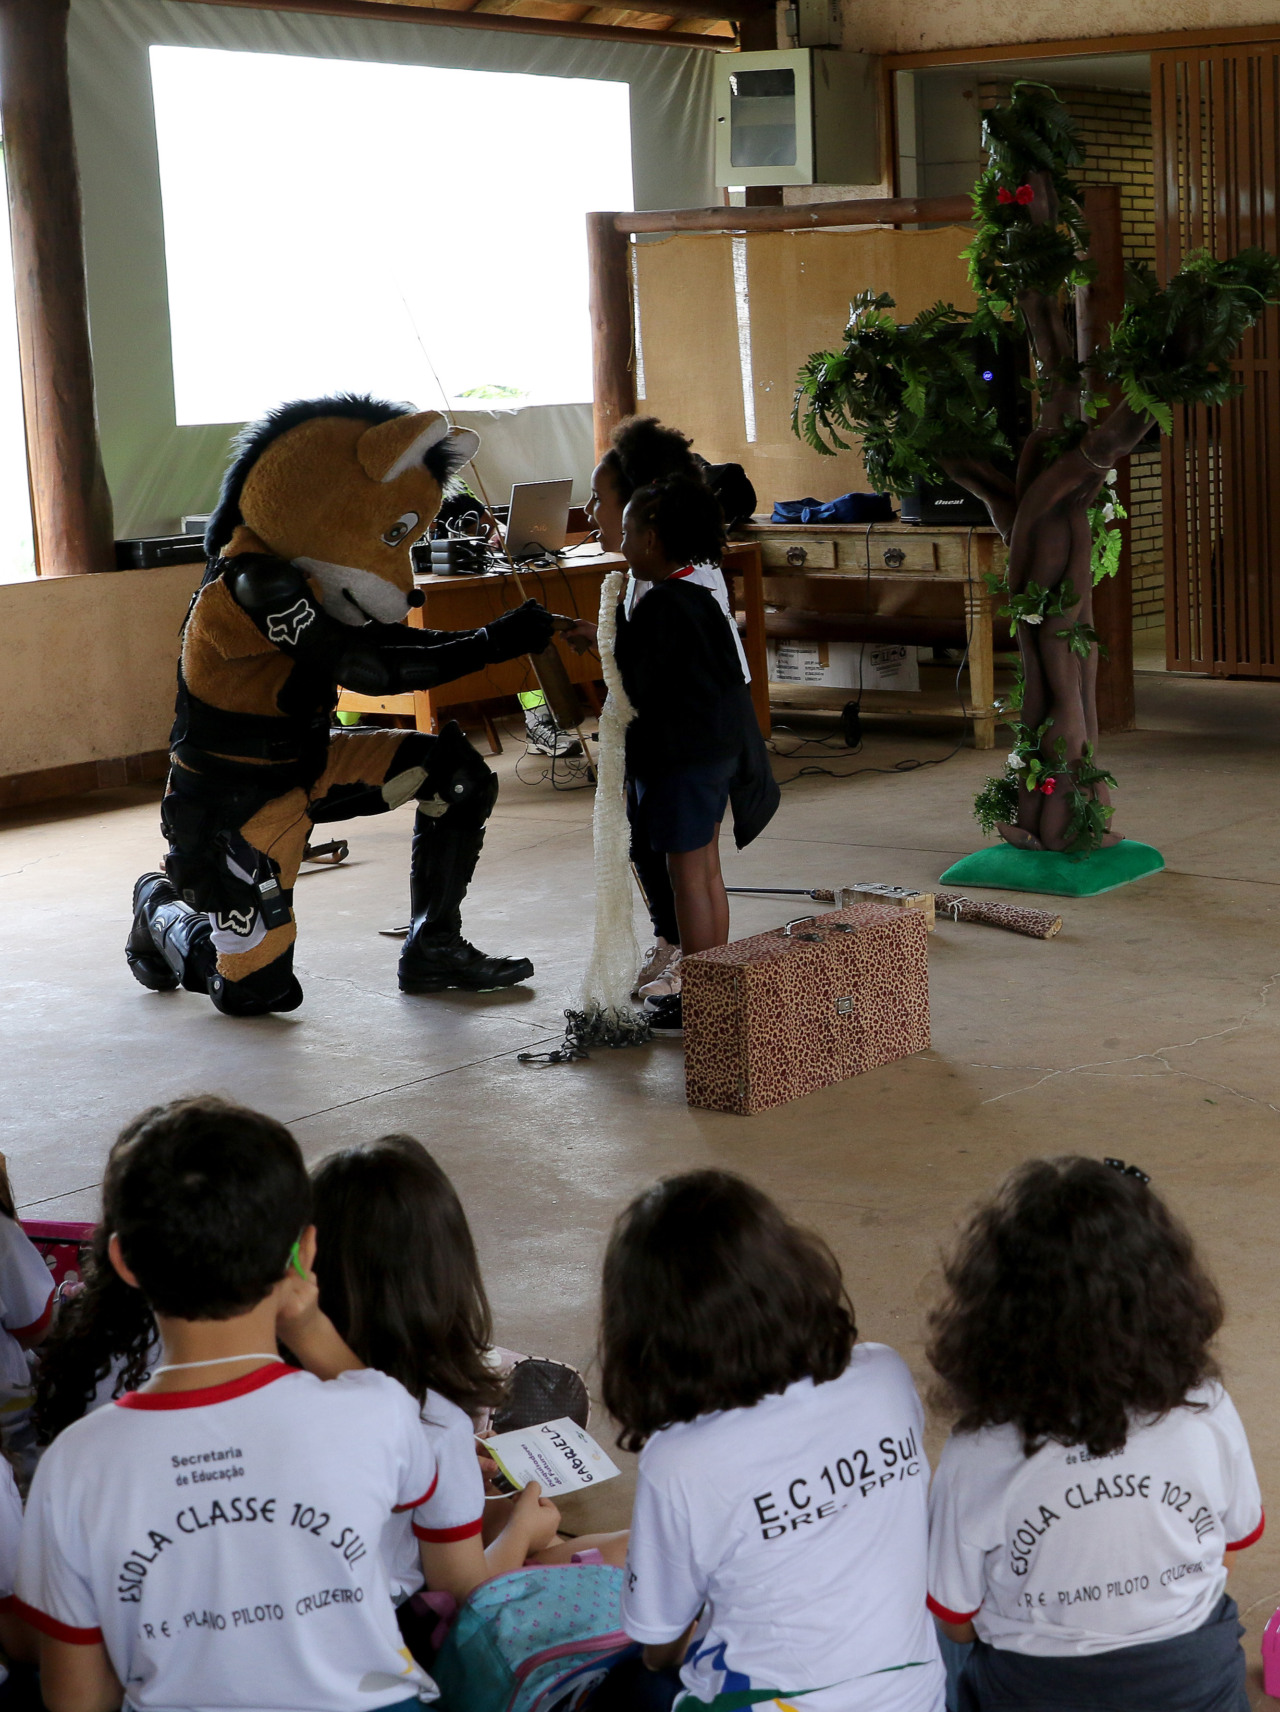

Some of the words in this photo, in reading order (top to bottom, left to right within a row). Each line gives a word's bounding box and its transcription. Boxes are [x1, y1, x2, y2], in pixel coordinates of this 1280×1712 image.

[171, 1446, 243, 1469] Secretaria
[537, 1453, 555, 1477] Futuro
[541, 1425, 594, 1483] GABRIELA
[176, 1474, 189, 1487] de
[192, 1466, 245, 1484] Educação
[753, 1478, 811, 1525] E.C
[820, 1449, 876, 1496] 102
[879, 1427, 918, 1467] Sul
[1010, 1505, 1061, 1577] ESCOLA
[1065, 1474, 1151, 1510] CLASSE
[1160, 1481, 1192, 1513] 102
[1189, 1506, 1214, 1544] SUL
[119, 1530, 173, 1604] ESCOLA
[176, 1497, 277, 1534] CLASSE
[290, 1503, 331, 1537] 102
[331, 1527, 367, 1571] SUL
[183, 1610, 226, 1630] PLANO
[232, 1603, 284, 1628] PILOTO
[295, 1587, 363, 1616] CRUZEIRO
[1058, 1586, 1101, 1606] PLANO
[1107, 1575, 1149, 1598] PILOTO
